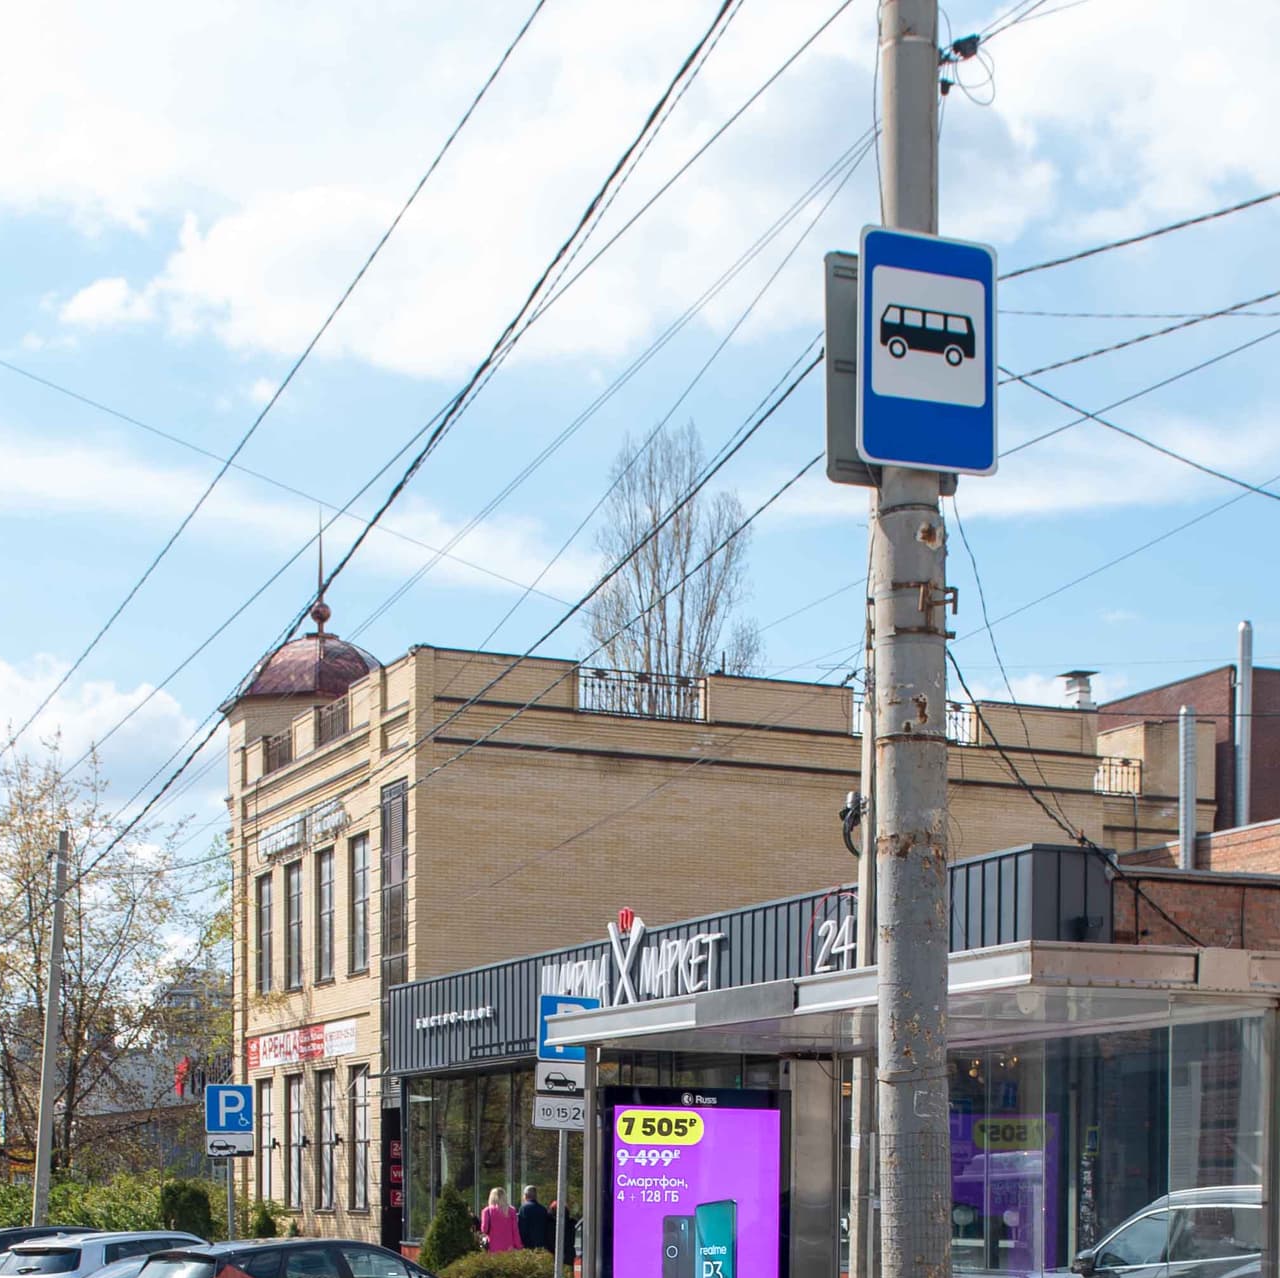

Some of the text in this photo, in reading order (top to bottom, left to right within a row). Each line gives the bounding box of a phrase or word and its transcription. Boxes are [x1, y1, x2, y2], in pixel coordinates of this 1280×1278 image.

[815, 915, 857, 972] 24
[639, 932, 726, 998] МАРКЕТ
[262, 1031, 299, 1060] АРЕНДА
[695, 1095, 718, 1104] Russ
[542, 1107, 552, 1117] 10
[557, 1108, 568, 1118] 15
[622, 1117, 635, 1135] 7
[617, 1149, 629, 1166] 9
[617, 1174, 688, 1189] Смартфон,
[617, 1190, 625, 1202] 4
[640, 1190, 661, 1203] 128
[665, 1190, 680, 1203] ГБ
[700, 1245, 727, 1255] realme
